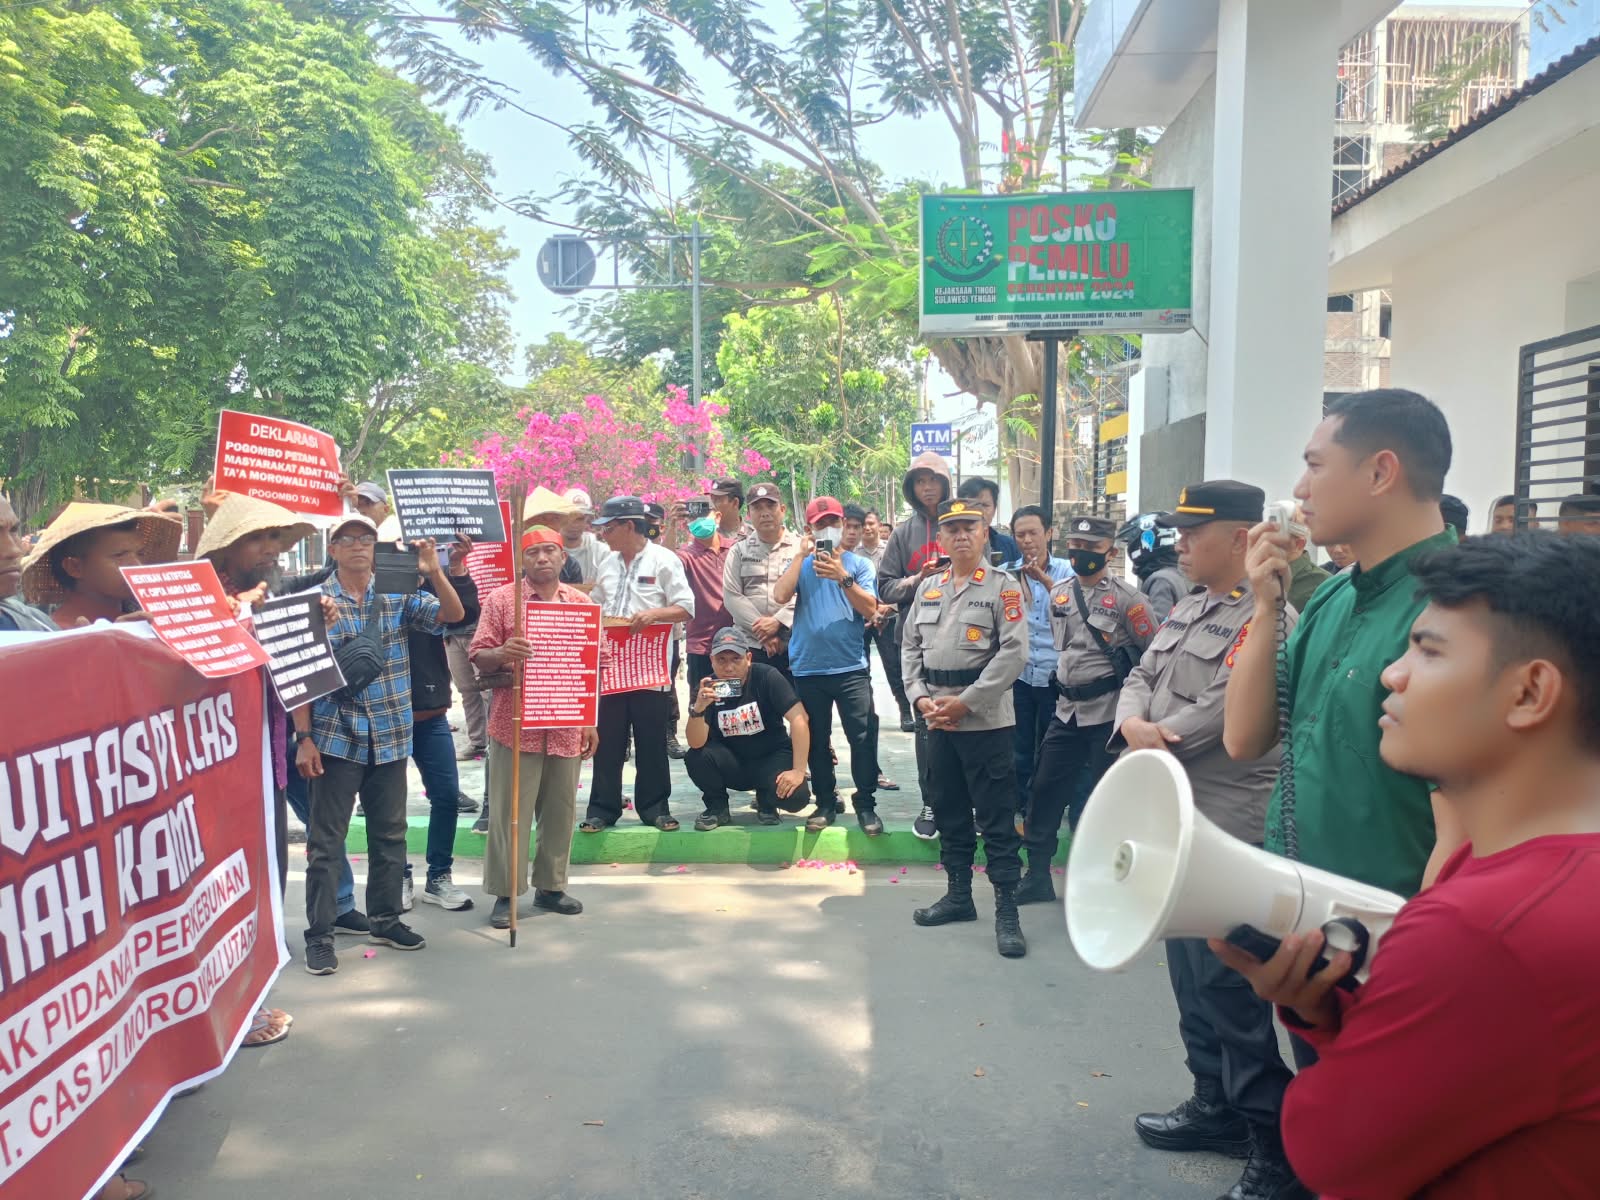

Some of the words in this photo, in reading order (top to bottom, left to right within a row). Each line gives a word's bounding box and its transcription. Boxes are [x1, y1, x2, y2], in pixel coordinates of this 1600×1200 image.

[1008, 203, 1116, 242] POSKO
[1008, 243, 1129, 281] PEMILU
[934, 286, 972, 295] KEJAKSAAN
[975, 286, 995, 295] TINGGI
[1006, 283, 1085, 302] SERENTAK
[1090, 281, 1135, 300] 2024
[934, 295, 968, 304] SULAWESI
[970, 294, 996, 303] TENGAH
[250, 423, 319, 449] DEKLARASI
[913, 429, 950, 443] ATM
[225, 440, 283, 458] POGOMBO
[284, 449, 318, 465] PETANI
[224, 454, 297, 473] MASYARAKAT
[298, 466, 323, 478] ADAT
[222, 467, 246, 478] TA'A
[249, 470, 308, 488] MOROWALI
[309, 480, 338, 493] UTARA
[393, 478, 414, 487] KAMI
[248, 488, 299, 502] (POGOMBO
[395, 488, 422, 497] TINGGI
[479, 497, 496, 506] PADA
[401, 508, 426, 516] AREAL
[426, 506, 470, 515] OPRASIONAL
[403, 518, 416, 527] PT.
[415, 517, 436, 525] CIPTA
[437, 516, 456, 525] AGRO
[456, 516, 476, 525] SAKTI
[475, 516, 484, 525] DI
[405, 528, 424, 537] KAB.
[459, 526, 483, 535] UTARA
[968, 600, 994, 609] POLRI
[1092, 606, 1121, 619] POLRI
[1201, 623, 1233, 639] POLRI
[115, 794, 205, 917] KAMI
[41, 950, 133, 1045] PIDANA
[133, 861, 244, 968] PERKEBUNAN
[29, 1062, 92, 1139] CAS
[97, 1035, 119, 1085] DI
[123, 942, 225, 1058] MOROWALI
